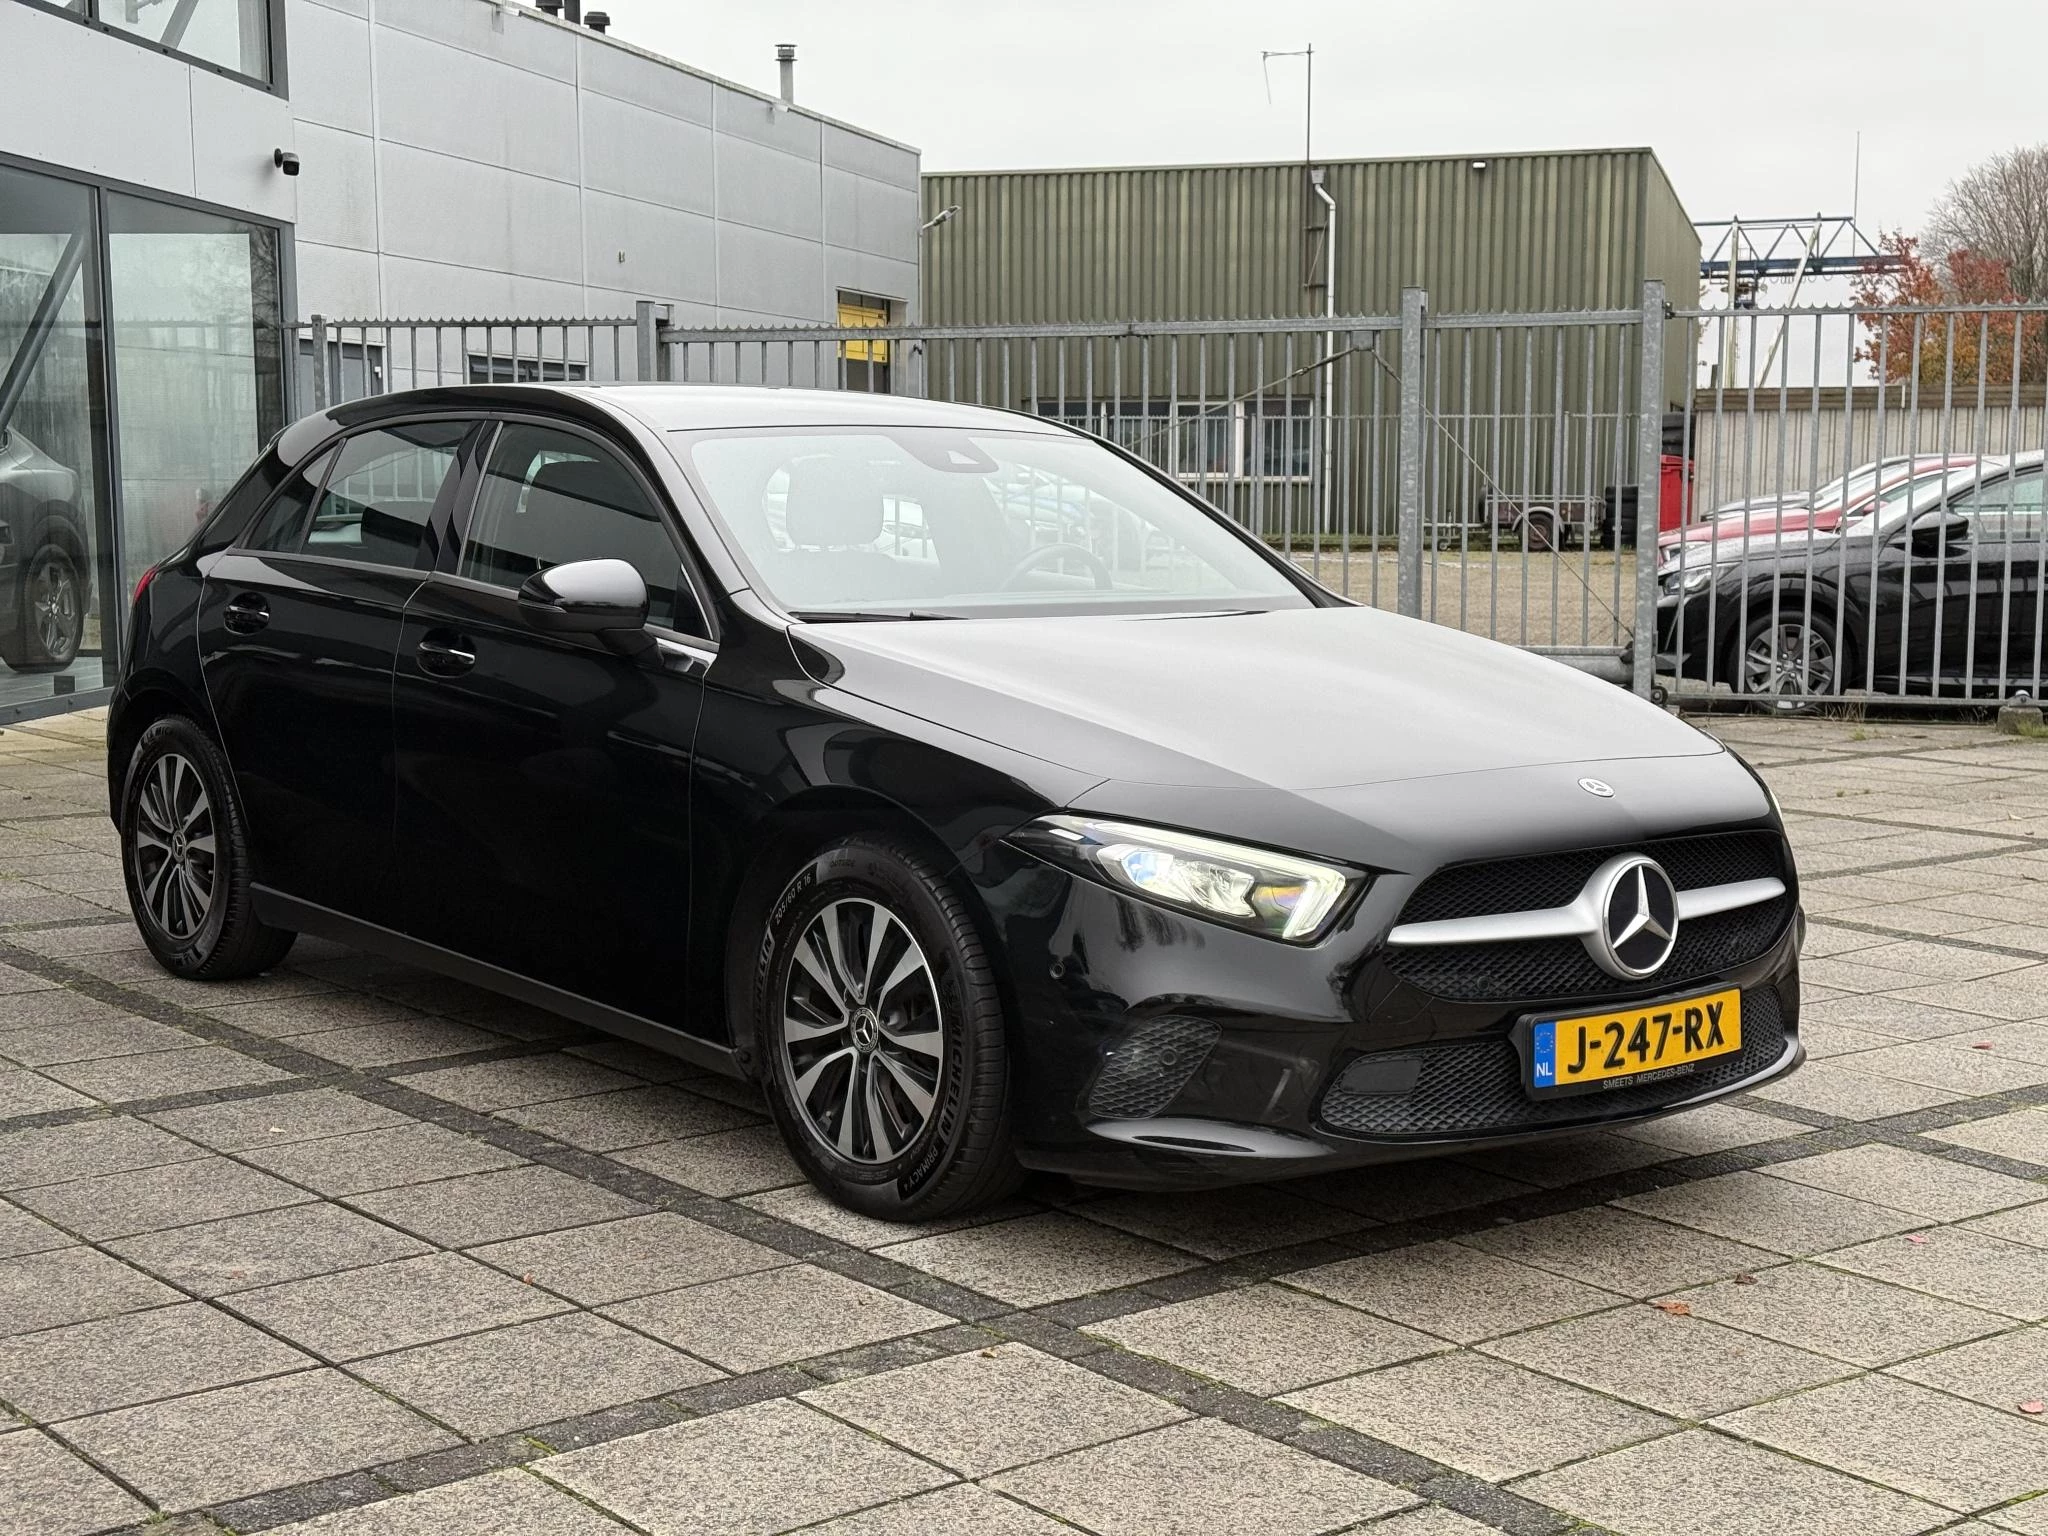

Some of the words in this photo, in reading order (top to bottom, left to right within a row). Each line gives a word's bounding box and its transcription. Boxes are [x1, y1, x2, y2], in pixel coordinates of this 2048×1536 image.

[796, 881, 803, 893] R
[803, 873, 812, 886] 16
[1567, 1001, 1725, 1074] J-247-RX
[941, 1016, 964, 1136] MICHELIN
[1536, 1063, 1552, 1078] NL
[1603, 1076, 1633, 1089] SMEETS
[1636, 1064, 1695, 1083] MERCEDES-BENZ
[909, 1145, 938, 1188] PRIMACY
